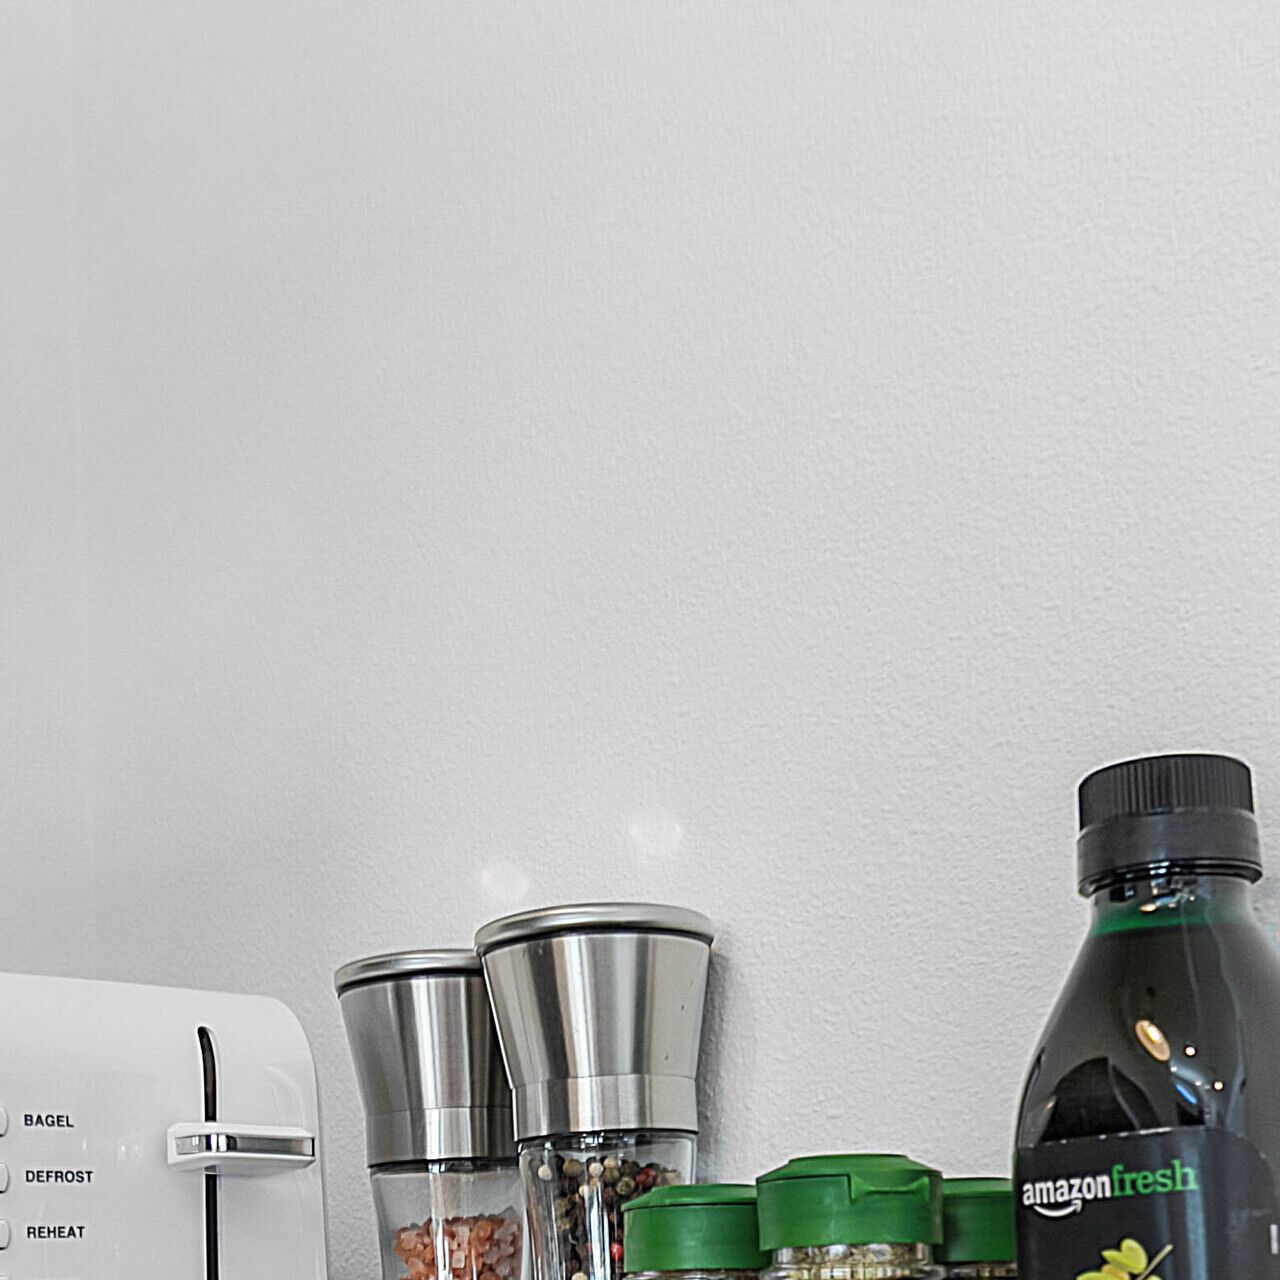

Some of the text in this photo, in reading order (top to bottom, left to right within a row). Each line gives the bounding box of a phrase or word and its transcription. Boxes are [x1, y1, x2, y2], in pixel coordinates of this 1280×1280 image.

[23, 1114, 75, 1129] BAGEL
[25, 1170, 93, 1184] DEFROST
[1022, 1160, 1198, 1205] amazonfresh
[26, 1226, 85, 1239] REHEAT
